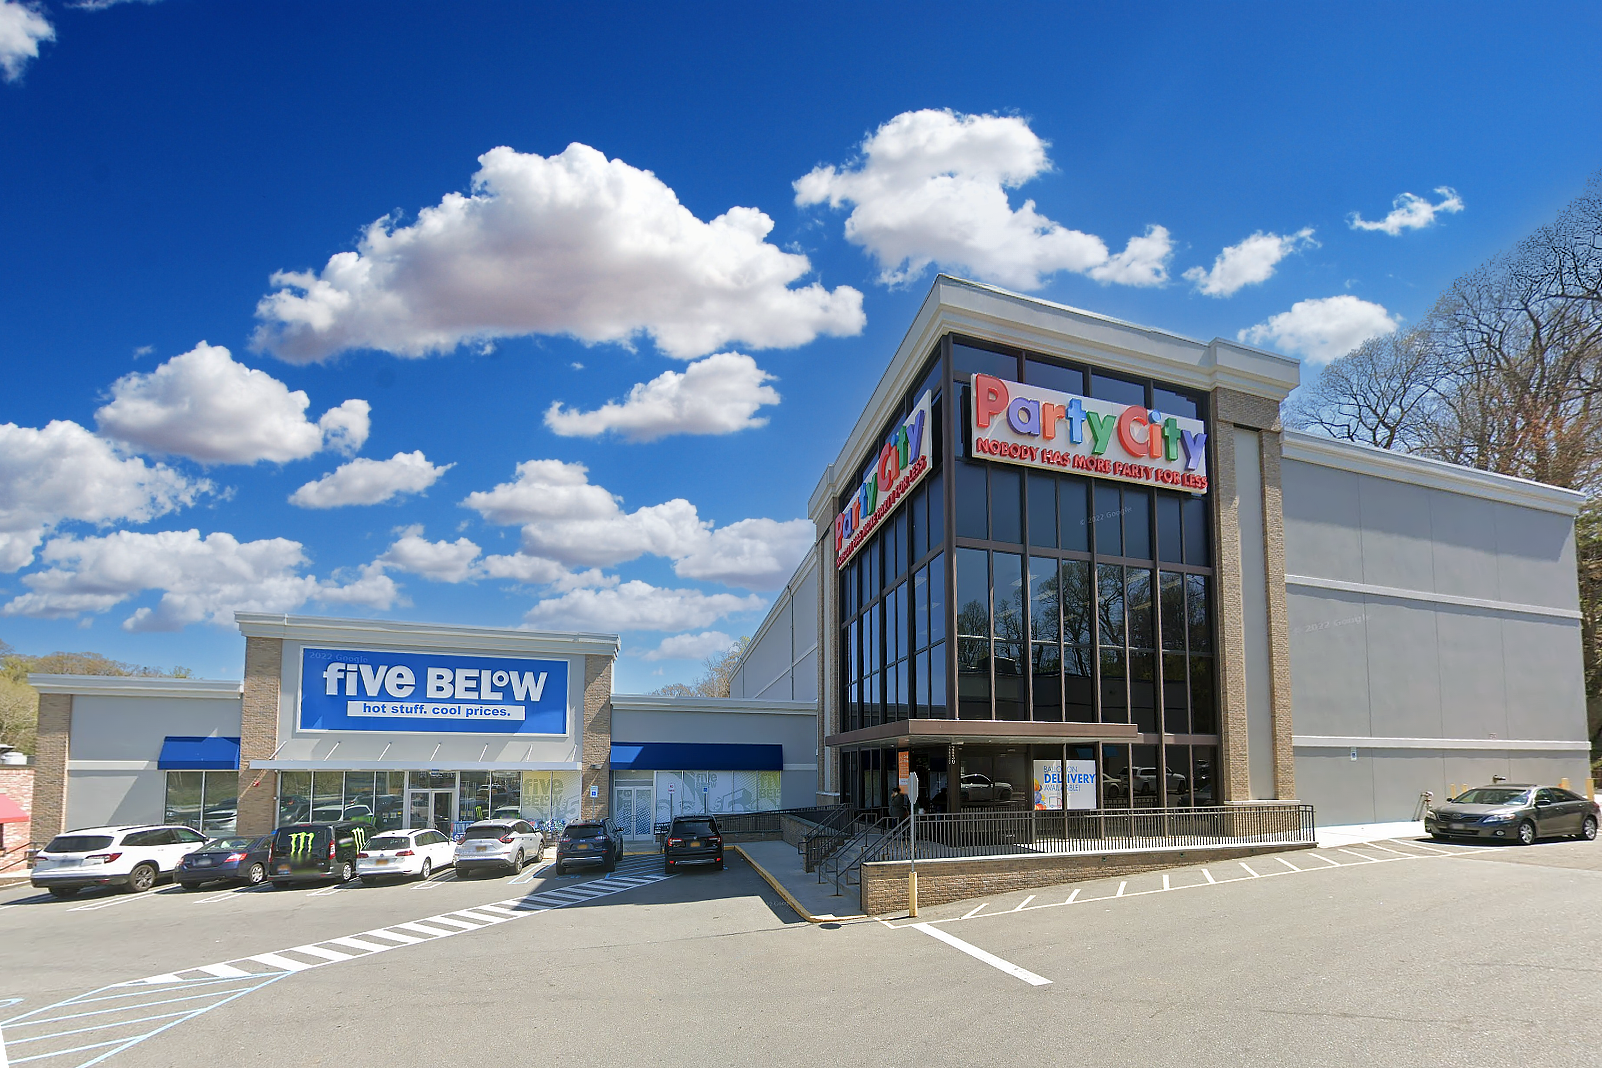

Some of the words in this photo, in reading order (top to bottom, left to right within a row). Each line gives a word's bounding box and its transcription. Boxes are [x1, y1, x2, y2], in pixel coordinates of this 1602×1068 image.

[976, 437, 1039, 462] NOBODY
[1041, 448, 1070, 467] HAS
[1072, 454, 1112, 474] MORE
[1113, 461, 1155, 480] PARTY
[1155, 468, 1181, 485] FOR
[1181, 473, 1208, 490] LESS
[323, 662, 416, 698] five
[426, 667, 548, 702] BELOW
[363, 703, 386, 713] hot
[391, 703, 427, 714] stuff.
[432, 705, 461, 716] cool
[466, 705, 511, 718] prices.
[1043, 773, 1096, 784] DELIVERY
